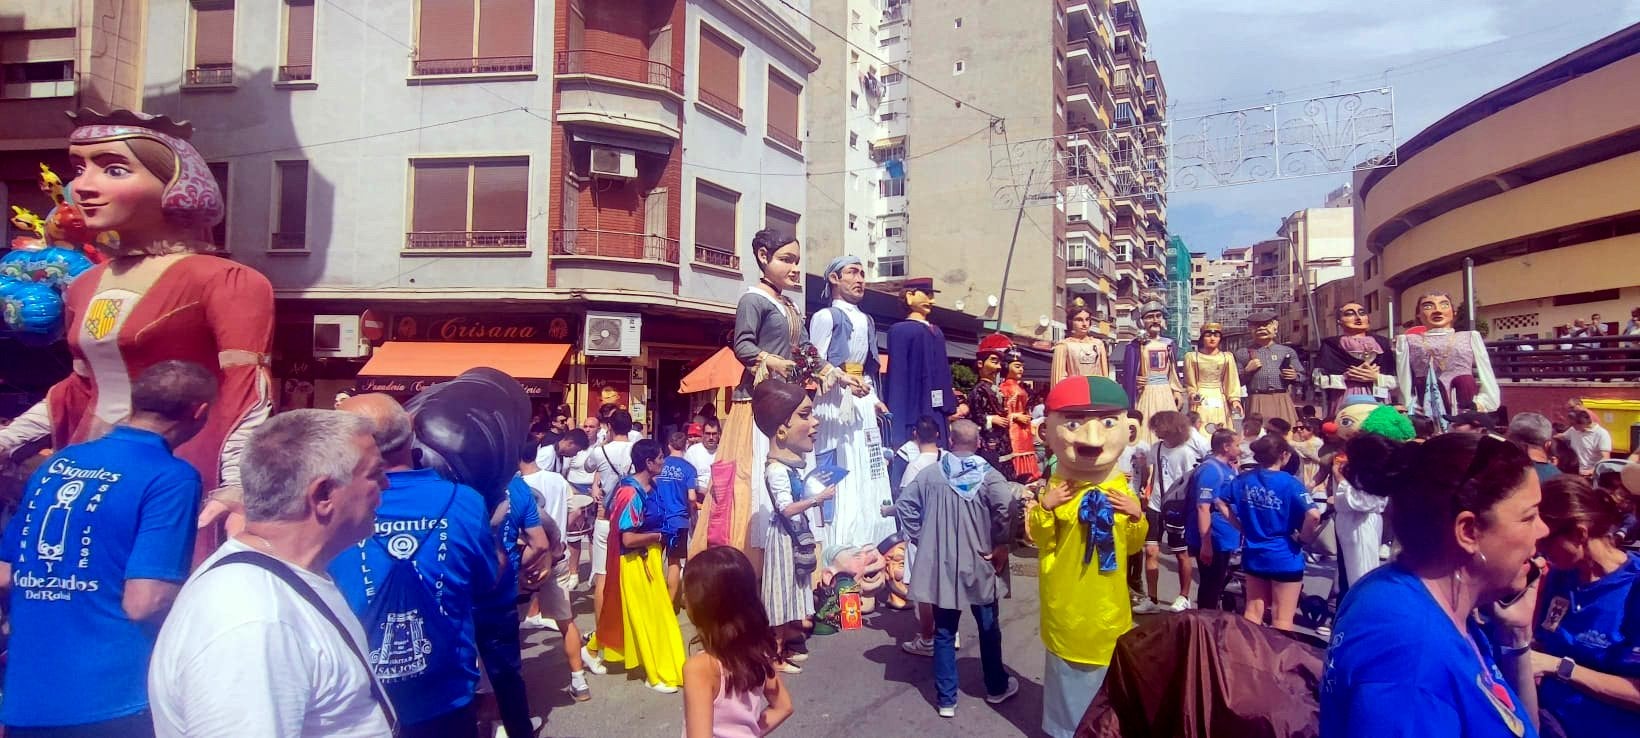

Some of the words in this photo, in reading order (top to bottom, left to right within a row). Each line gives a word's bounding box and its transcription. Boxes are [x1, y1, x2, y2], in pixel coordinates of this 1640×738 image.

[48, 457, 122, 482] Gigantes
[85, 484, 109, 513] SAN
[17, 476, 51, 563] VILLENA
[374, 516, 449, 537] igantes
[437, 531, 448, 562] SAN
[45, 561, 54, 573] Y
[13, 569, 99, 592] Cabezudos
